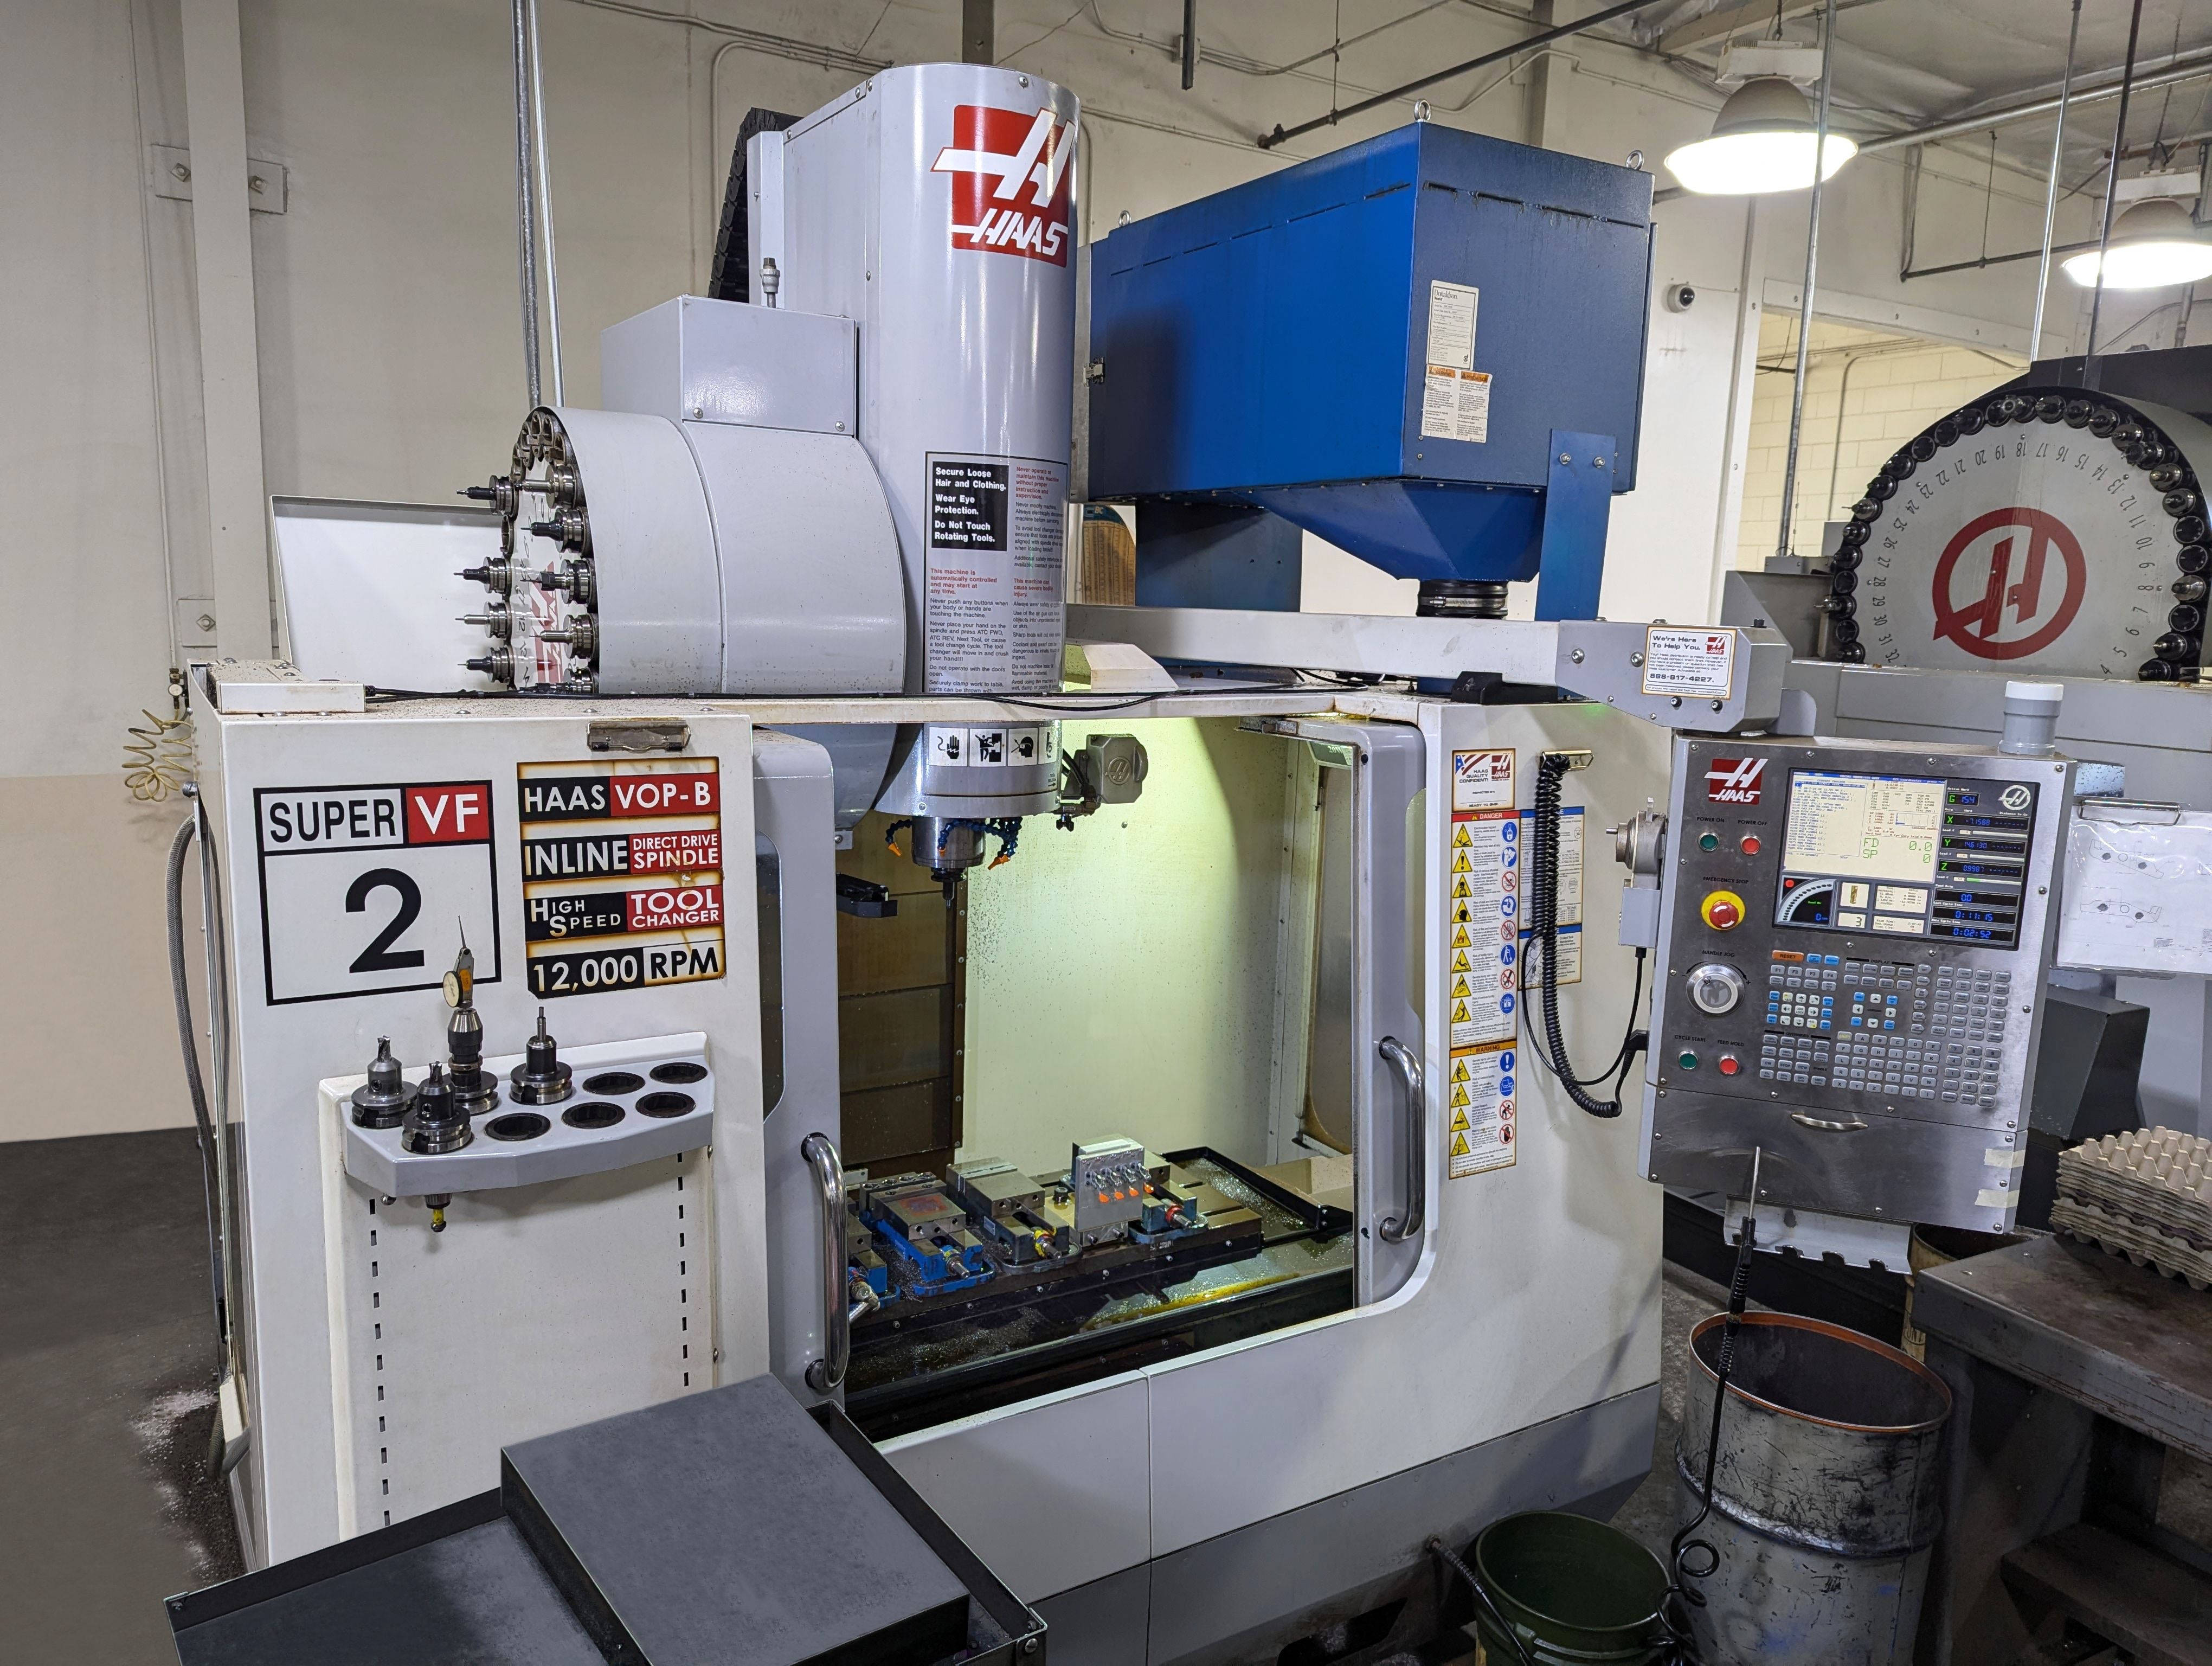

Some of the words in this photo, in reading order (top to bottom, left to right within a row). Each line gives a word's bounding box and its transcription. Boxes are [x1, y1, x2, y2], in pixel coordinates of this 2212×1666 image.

[951, 208, 1068, 256] HAAS
[1995, 445, 2005, 460] 19
[2016, 442, 2026, 457] 18
[2036, 443, 2049, 457] 17
[2055, 446, 2069, 462] 16
[1975, 449, 1987, 465] 20
[2075, 454, 2089, 470] 15
[936, 467, 964, 476] Secure
[968, 469, 991, 477] Loose
[1954, 459, 1966, 475] 21
[2092, 464, 2108, 480] 14
[1936, 470, 1949, 485] 22
[973, 480, 1006, 491] Clothing.
[1920, 483, 1933, 499] 23
[2108, 479, 2124, 494] 13
[960, 495, 975, 504] Eye
[2120, 495, 2137, 511] 12
[935, 505, 979, 515] Protection.
[1905, 499, 1919, 515] 24
[967, 522, 990, 530] Touch
[1894, 517, 1907, 531] 25
[2129, 514, 2146, 528] 11
[935, 533, 968, 542] Rotating
[972, 534, 995, 542] Tools.
[1883, 536, 1898, 549] 26
[2136, 537, 2153, 550] 10
[1878, 556, 1891, 568] 27
[1873, 577, 1886, 587] 28
[1873, 596, 1885, 607] 29
[1874, 614, 1887, 626] 30
[1879, 633, 1893, 645] 31
[1885, 649, 1899, 663] 32
[2113, 646, 2126, 657] 5
[2100, 664, 2112, 675] 4
[1650, 674, 1714, 682] 888-817-4227.
[524, 784, 606, 813] HAAS
[1709, 789, 1760, 802] HAAS
[269, 798, 395, 843] SUPER
[415, 793, 479, 835] VF
[633, 836, 677, 850] DIRECT
[681, 834, 717, 847] DRIVE
[1863, 837, 1879, 847] FD
[1909, 841, 1932, 851] 0.0
[525, 845, 627, 876] INLINE
[634, 848, 718, 868] SPINDLE
[1862, 849, 1877, 859] SP
[1923, 854, 1931, 863] 0
[1941, 862, 1947, 870] Z
[630, 890, 719, 914] TOOL
[530, 899, 585, 922] HIGH
[632, 908, 719, 927] CHANGER
[345, 868, 425, 973] 2
[549, 913, 621, 938] SPEED
[1856, 917, 1862, 927] 3
[534, 956, 638, 992] 12,000
[651, 946, 718, 979] RPM
[1476, 1045, 1500, 1053] WARNING
